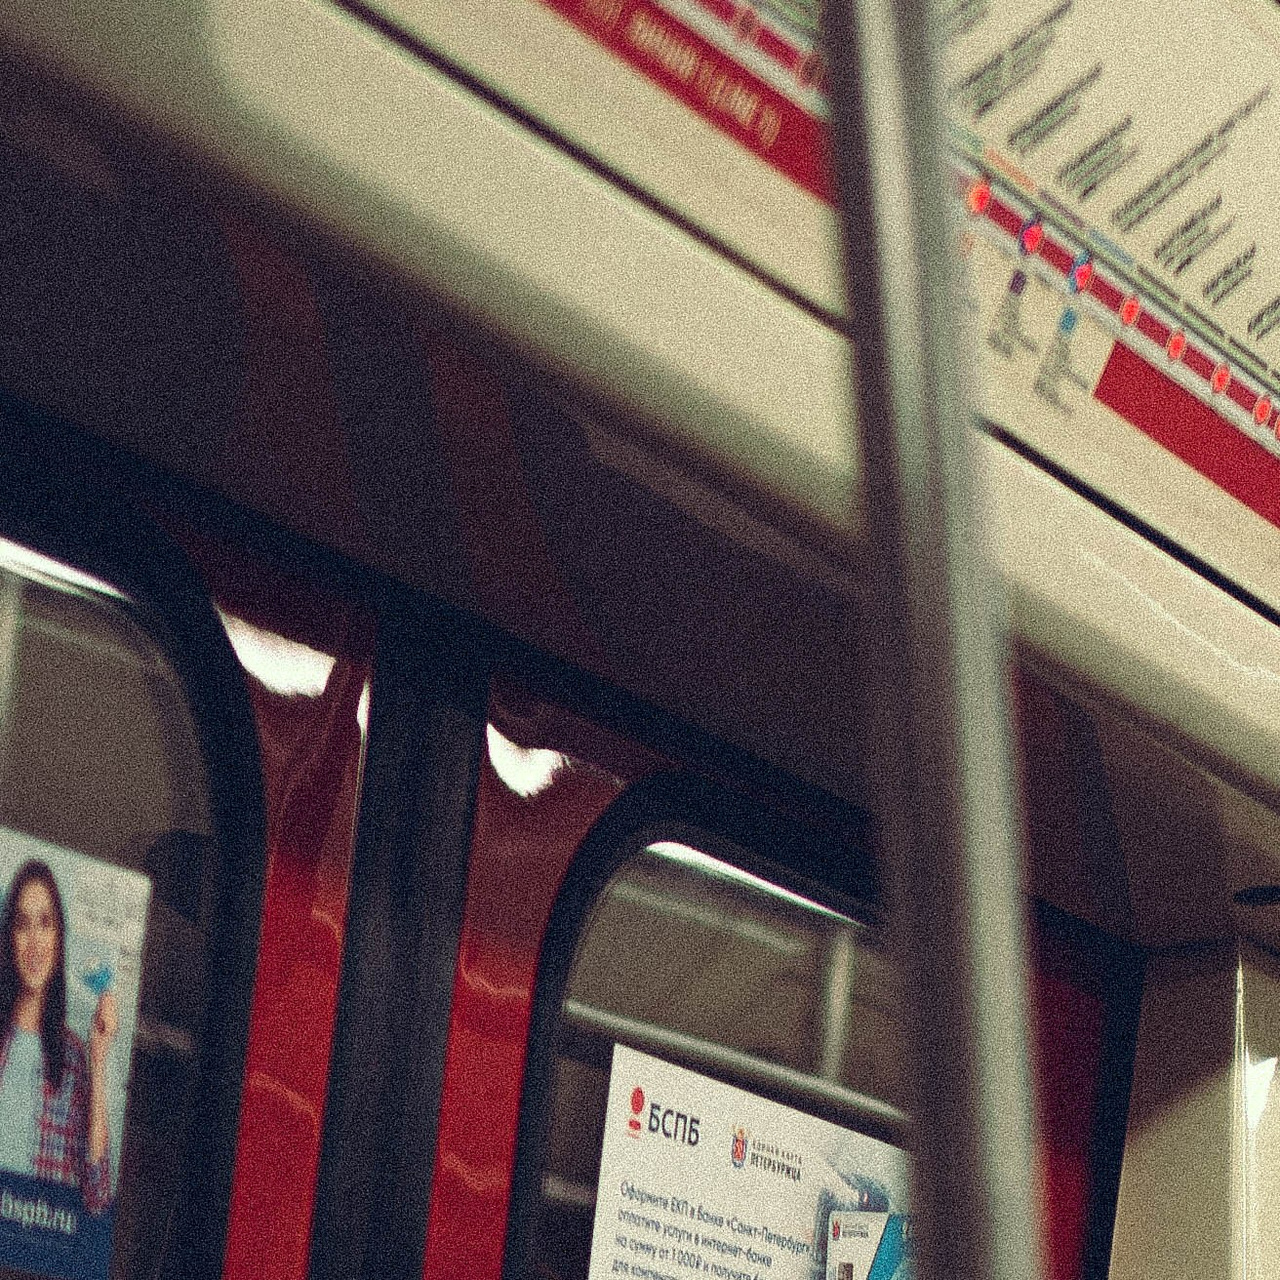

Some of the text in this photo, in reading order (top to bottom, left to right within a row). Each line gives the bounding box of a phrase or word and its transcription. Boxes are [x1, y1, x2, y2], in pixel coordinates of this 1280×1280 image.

[648, 1103, 700, 1147] БСПБ
[620, 1180, 669, 1210] Оформите
[615, 1234, 628, 1248] на
[629, 1238, 657, 1261] сумму
[618, 1208, 661, 1233] оплатите
[662, 1225, 693, 1243] услуги
[701, 1238, 772, 1268] интернет-банке
